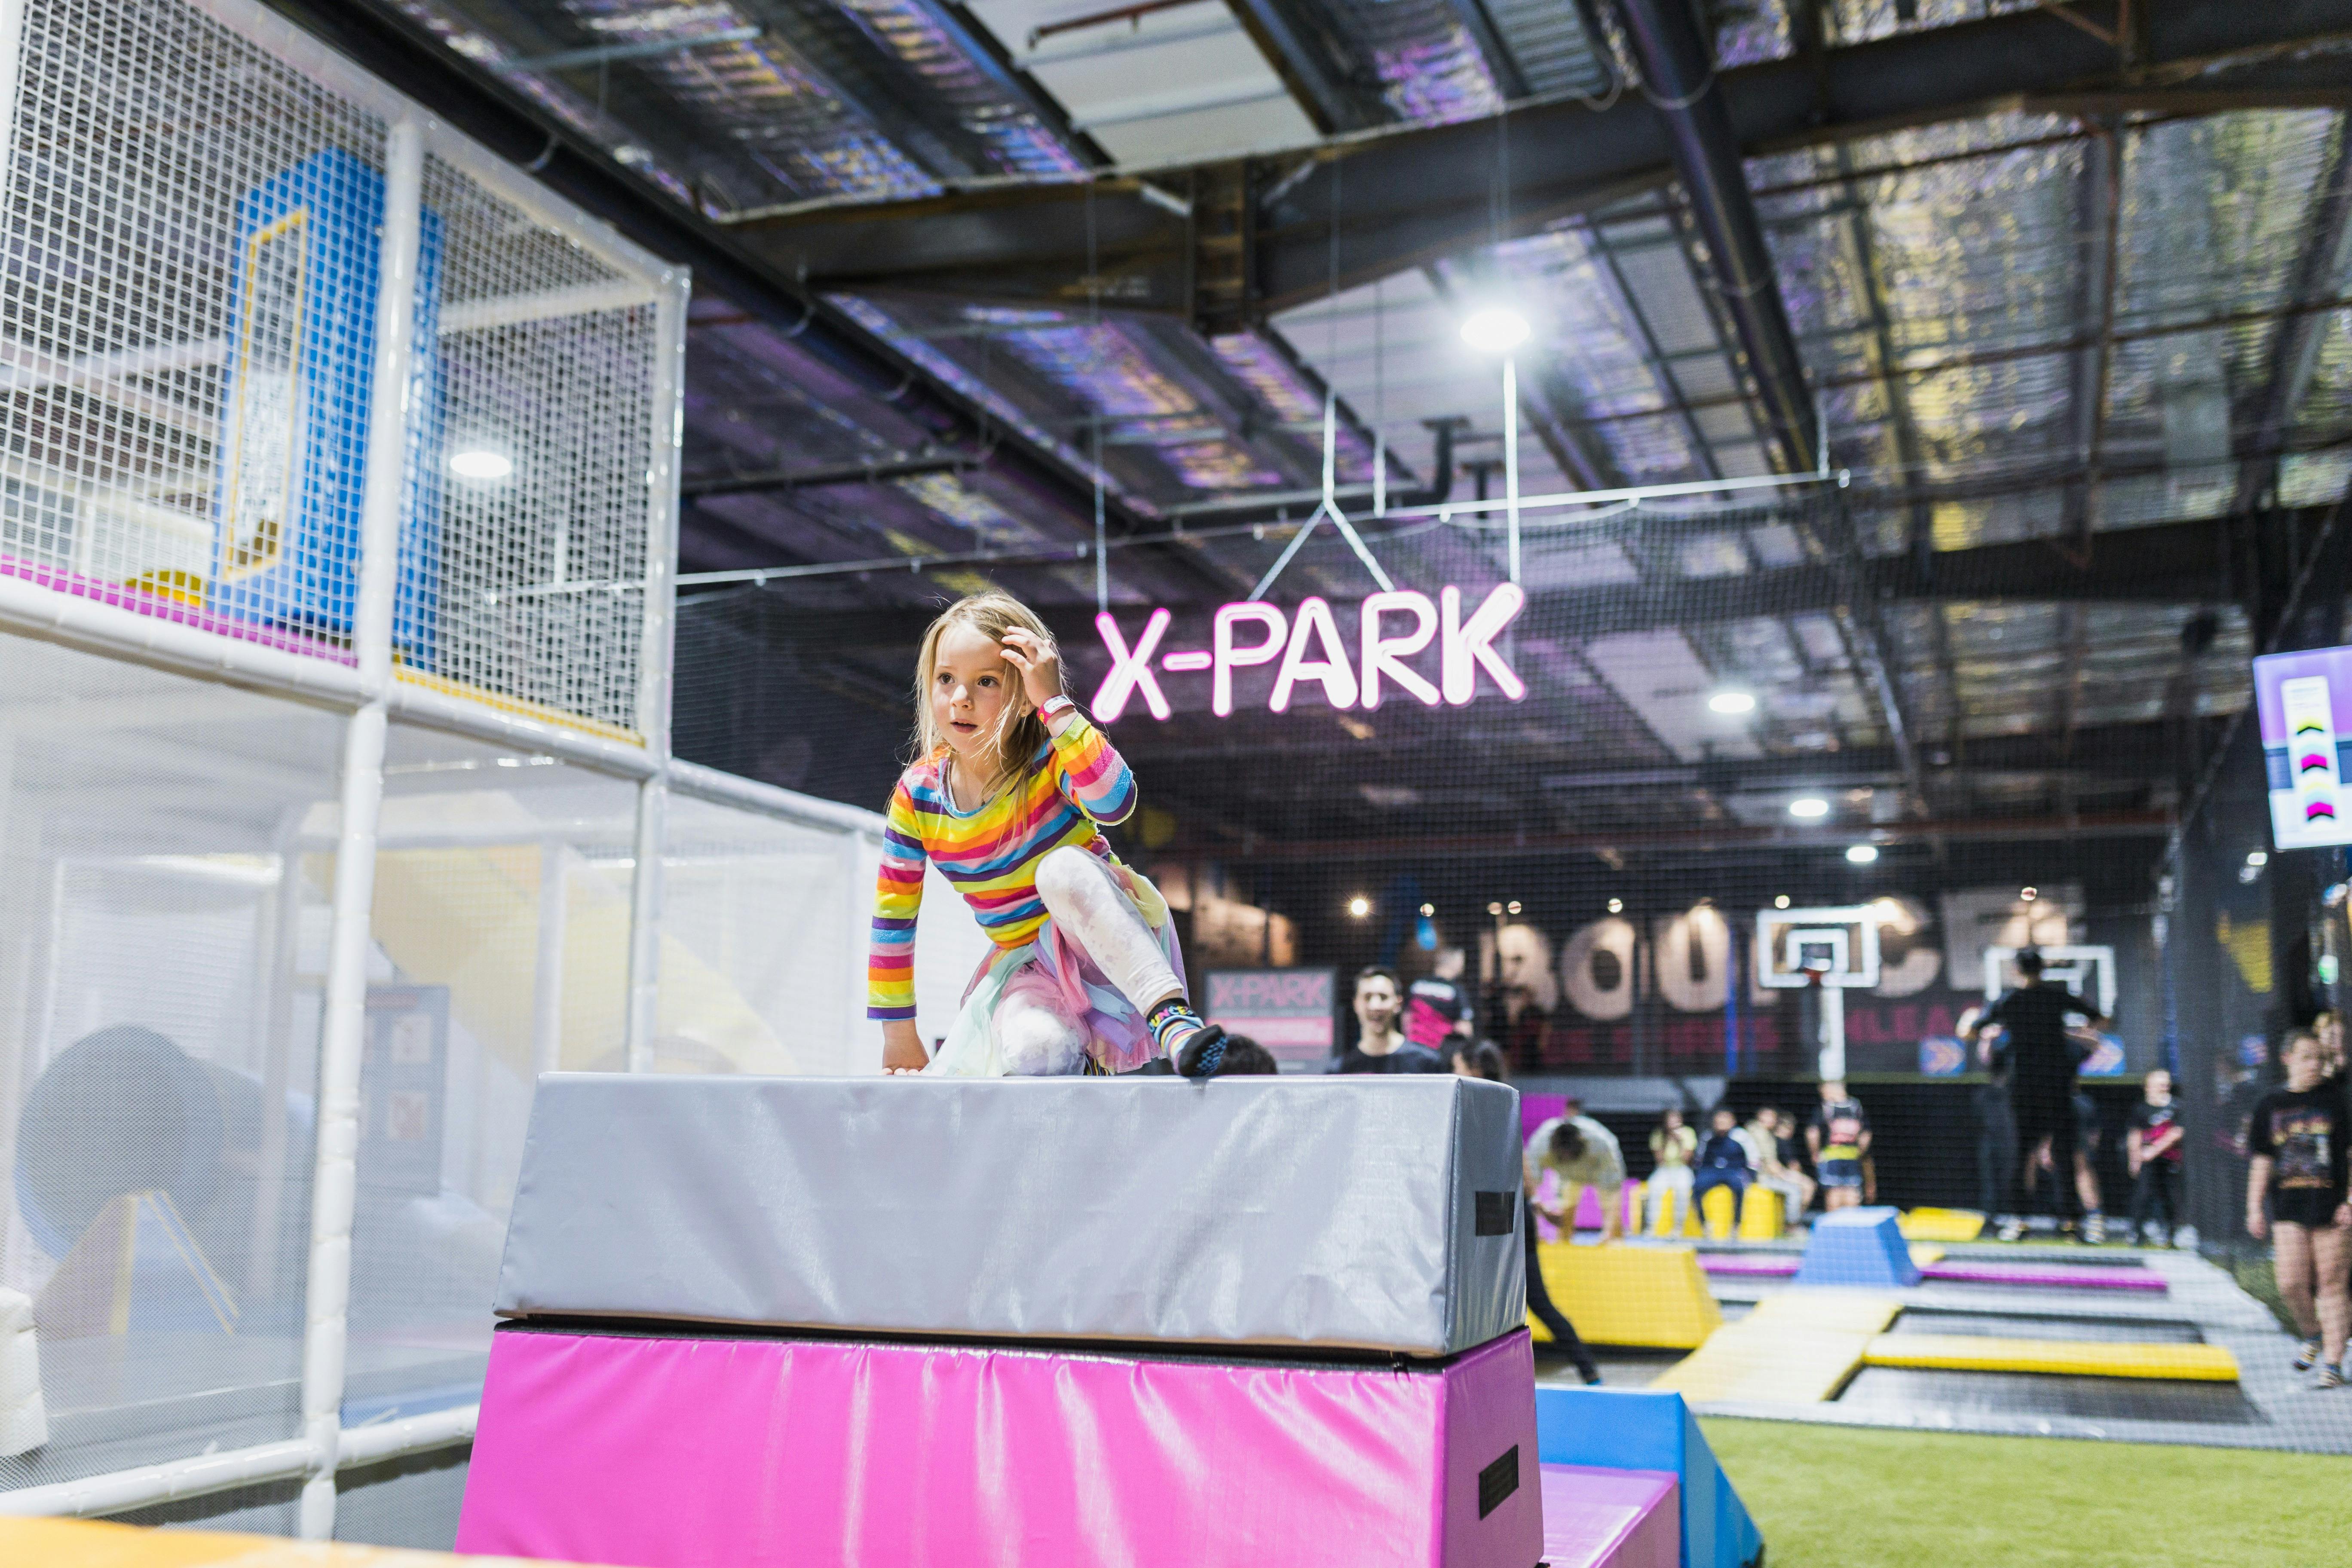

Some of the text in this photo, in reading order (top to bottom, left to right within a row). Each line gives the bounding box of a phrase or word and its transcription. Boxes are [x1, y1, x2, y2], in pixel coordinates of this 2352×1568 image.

[1090, 581, 1526, 723] X-PARK
[1212, 974, 1328, 1008] X-PARK
[1480, 885, 2090, 1022] BOUCE
